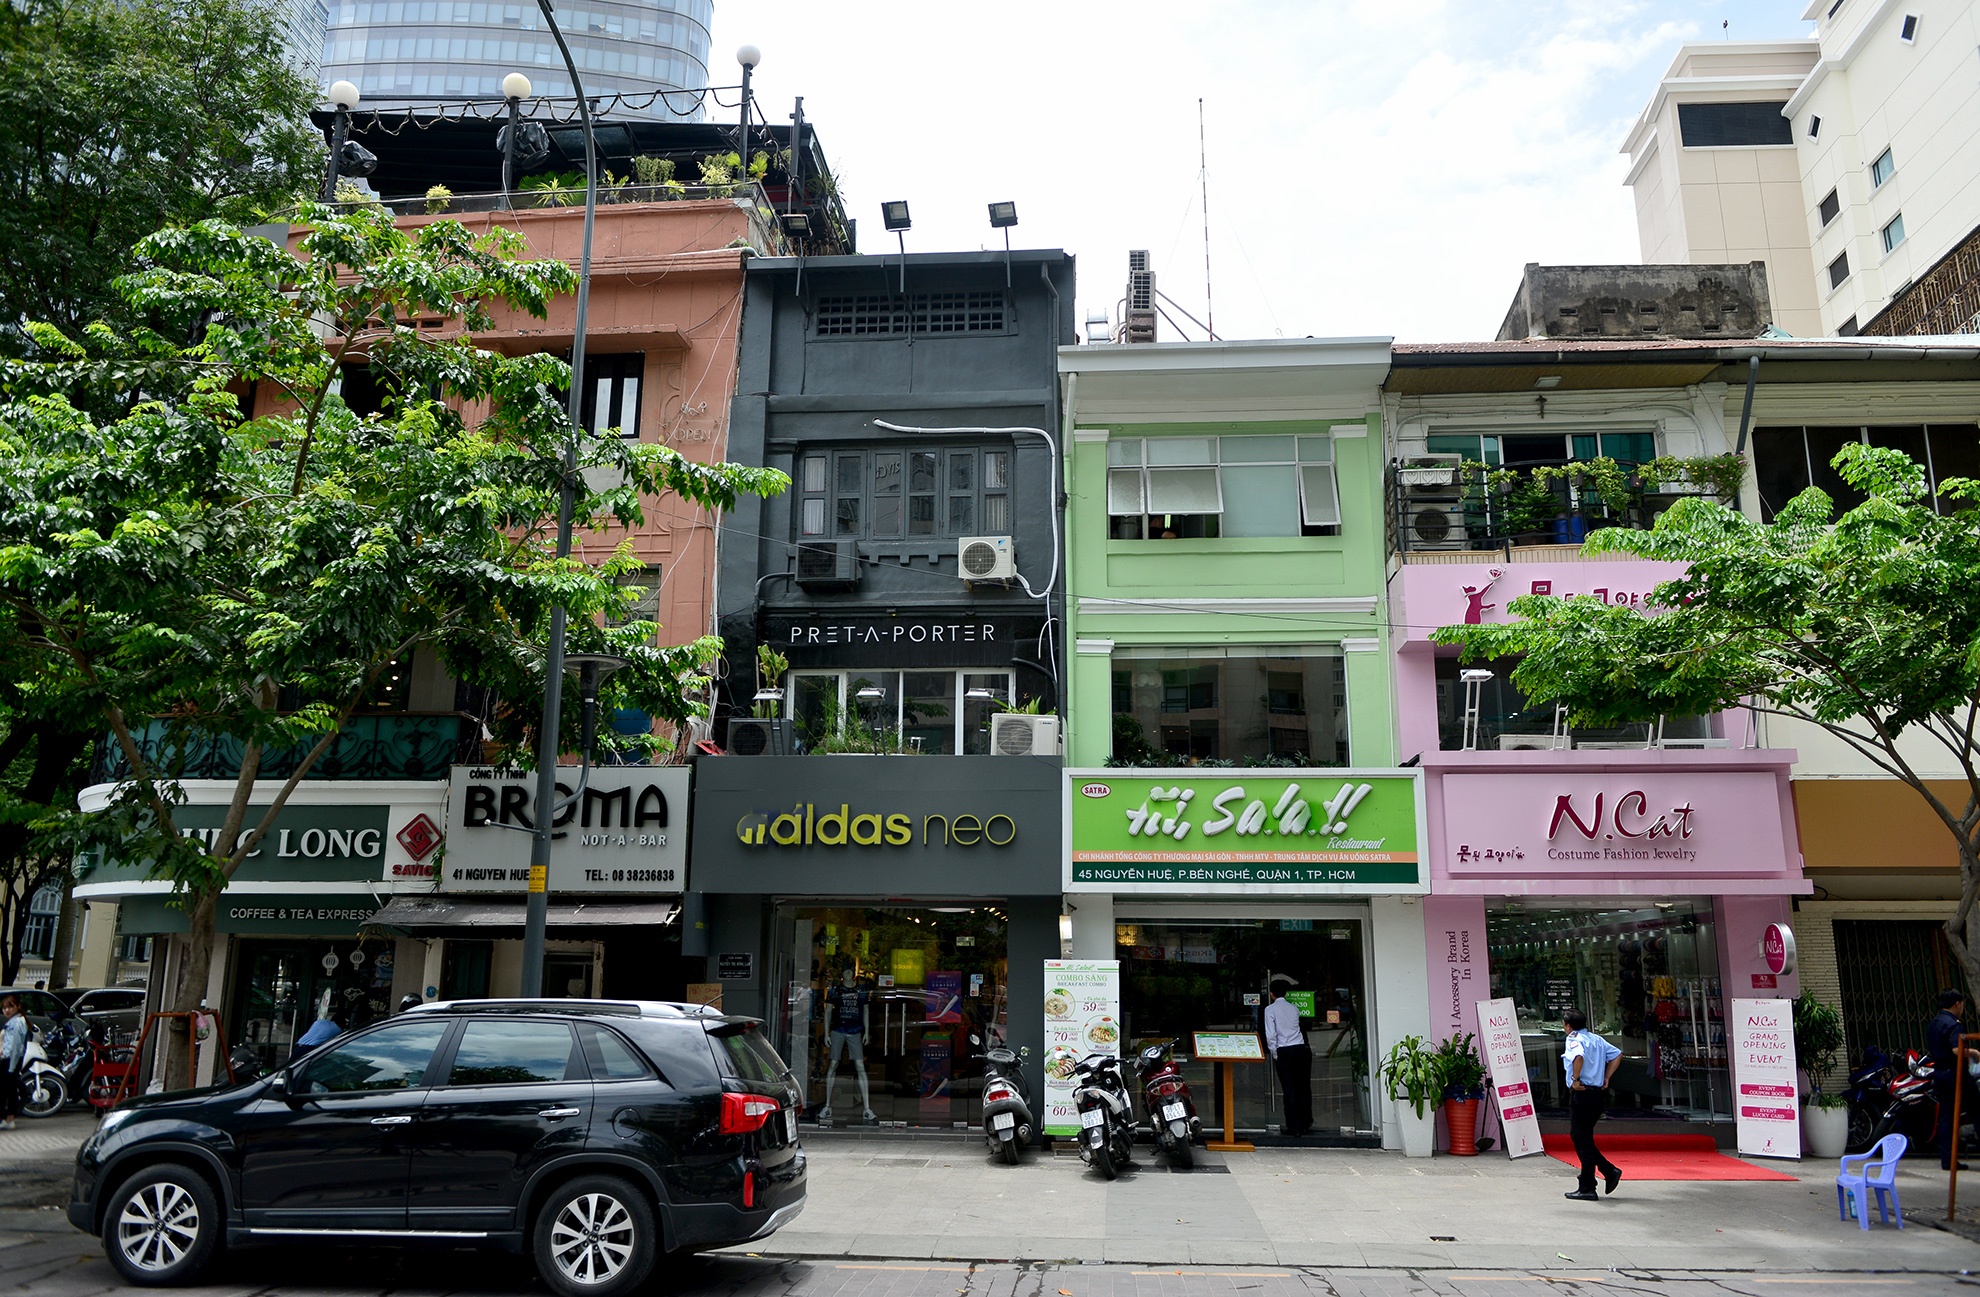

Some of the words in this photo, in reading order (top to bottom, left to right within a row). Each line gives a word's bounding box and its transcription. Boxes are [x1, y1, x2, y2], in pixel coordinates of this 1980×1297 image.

[674, 429, 711, 440] OPEN
[791, 624, 995, 643] PRET-A-PORTER
[506, 769, 527, 779] TNHH
[1083, 786, 1109, 795] SATRA
[464, 783, 668, 833] BROMA
[1546, 790, 1695, 841] N.Cat
[923, 814, 1016, 845] neo
[277, 828, 381, 858] LONG
[1326, 836, 1385, 850] Restaurant
[1091, 851, 1114, 860] NHÁNH
[1134, 851, 1151, 860] CÔNG
[1547, 847, 1600, 860] Costume
[1603, 847, 1649, 860] Fashion
[1652, 847, 1696, 862] Jewelry
[391, 864, 435, 877] SAVIC
[453, 870, 463, 880] 41
[465, 869, 506, 880] NGUYEN
[510, 869, 530, 880] HUE
[585, 869, 609, 881] TEL:
[612, 869, 624, 881] 08
[626, 869, 675, 881] 38236838
[1078, 870, 1092, 879] 45
[1094, 868, 1144, 879] NGUYỄN
[1294, 871, 1304, 880] 1,
[1307, 871, 1326, 880] TP.
[1328, 871, 1356, 880] HCM
[230, 908, 276, 920] COFFEE
[278, 908, 287, 920] &
[289, 908, 314, 920] TEA
[317, 908, 373, 920] EXPRESS
[1281, 919, 1309, 930] EXIT
[1446, 931, 1457, 963] Brand
[1461, 930, 1470, 963] Korea
[1462, 968, 1471, 981] In
[1451, 967, 1460, 1020] Accessory
[1083, 1002, 1097, 1011] 59
[1054, 1032, 1068, 1041] 70
[1493, 1032, 1512, 1041] GRAND
[1749, 1033, 1779, 1041] GRAND
[1490, 1040, 1517, 1050] OPENING
[1743, 1041, 1787, 1049] OPENING
[1497, 1053, 1517, 1064] EVENT
[1750, 1054, 1783, 1063] EVENT
[1053, 1106, 1067, 1116] 60
